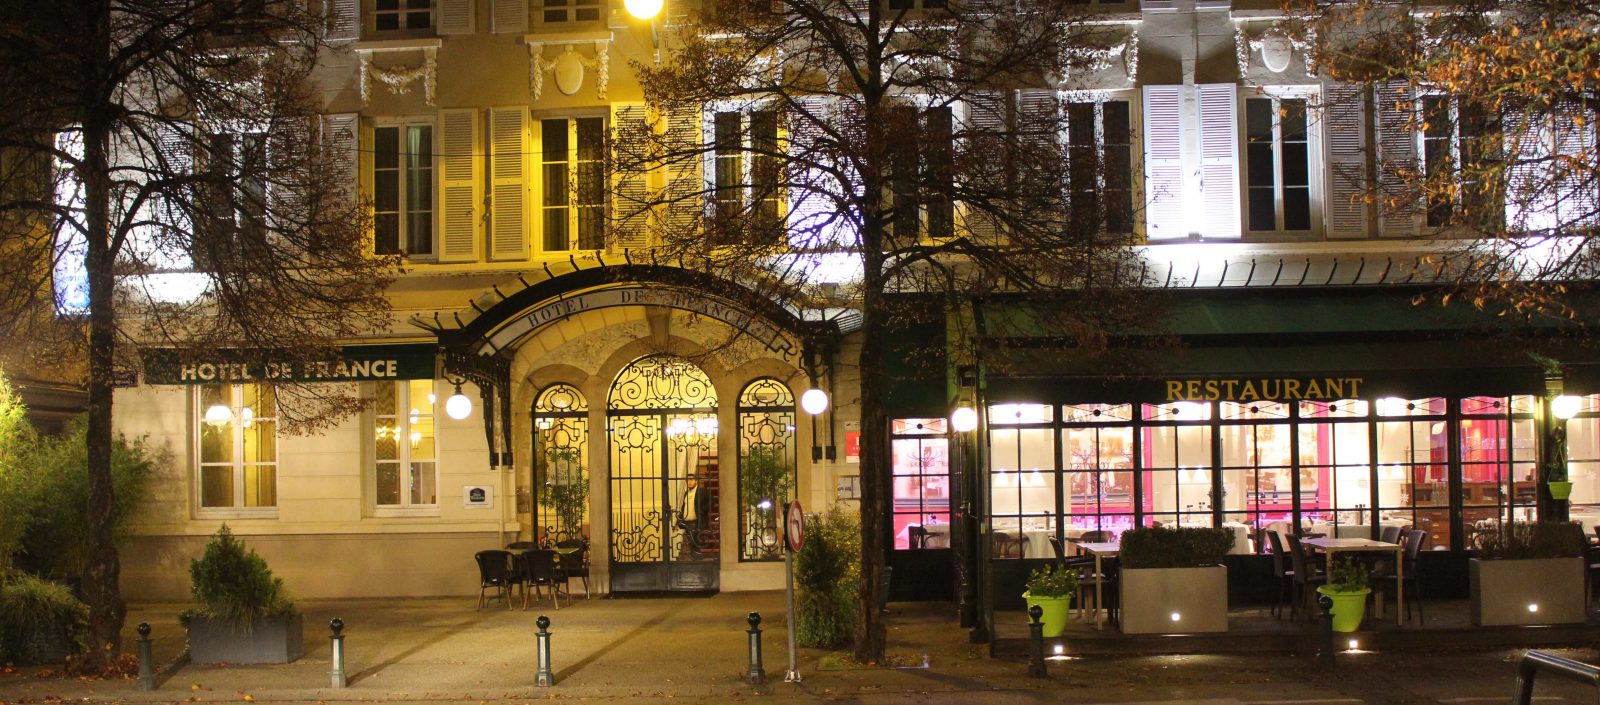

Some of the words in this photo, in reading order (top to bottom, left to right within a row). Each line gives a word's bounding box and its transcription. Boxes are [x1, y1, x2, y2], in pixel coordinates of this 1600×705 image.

[621, 290, 643, 304] DE
[181, 361, 253, 381] HOTEL
[1166, 378, 1363, 401] RESTAURANT
